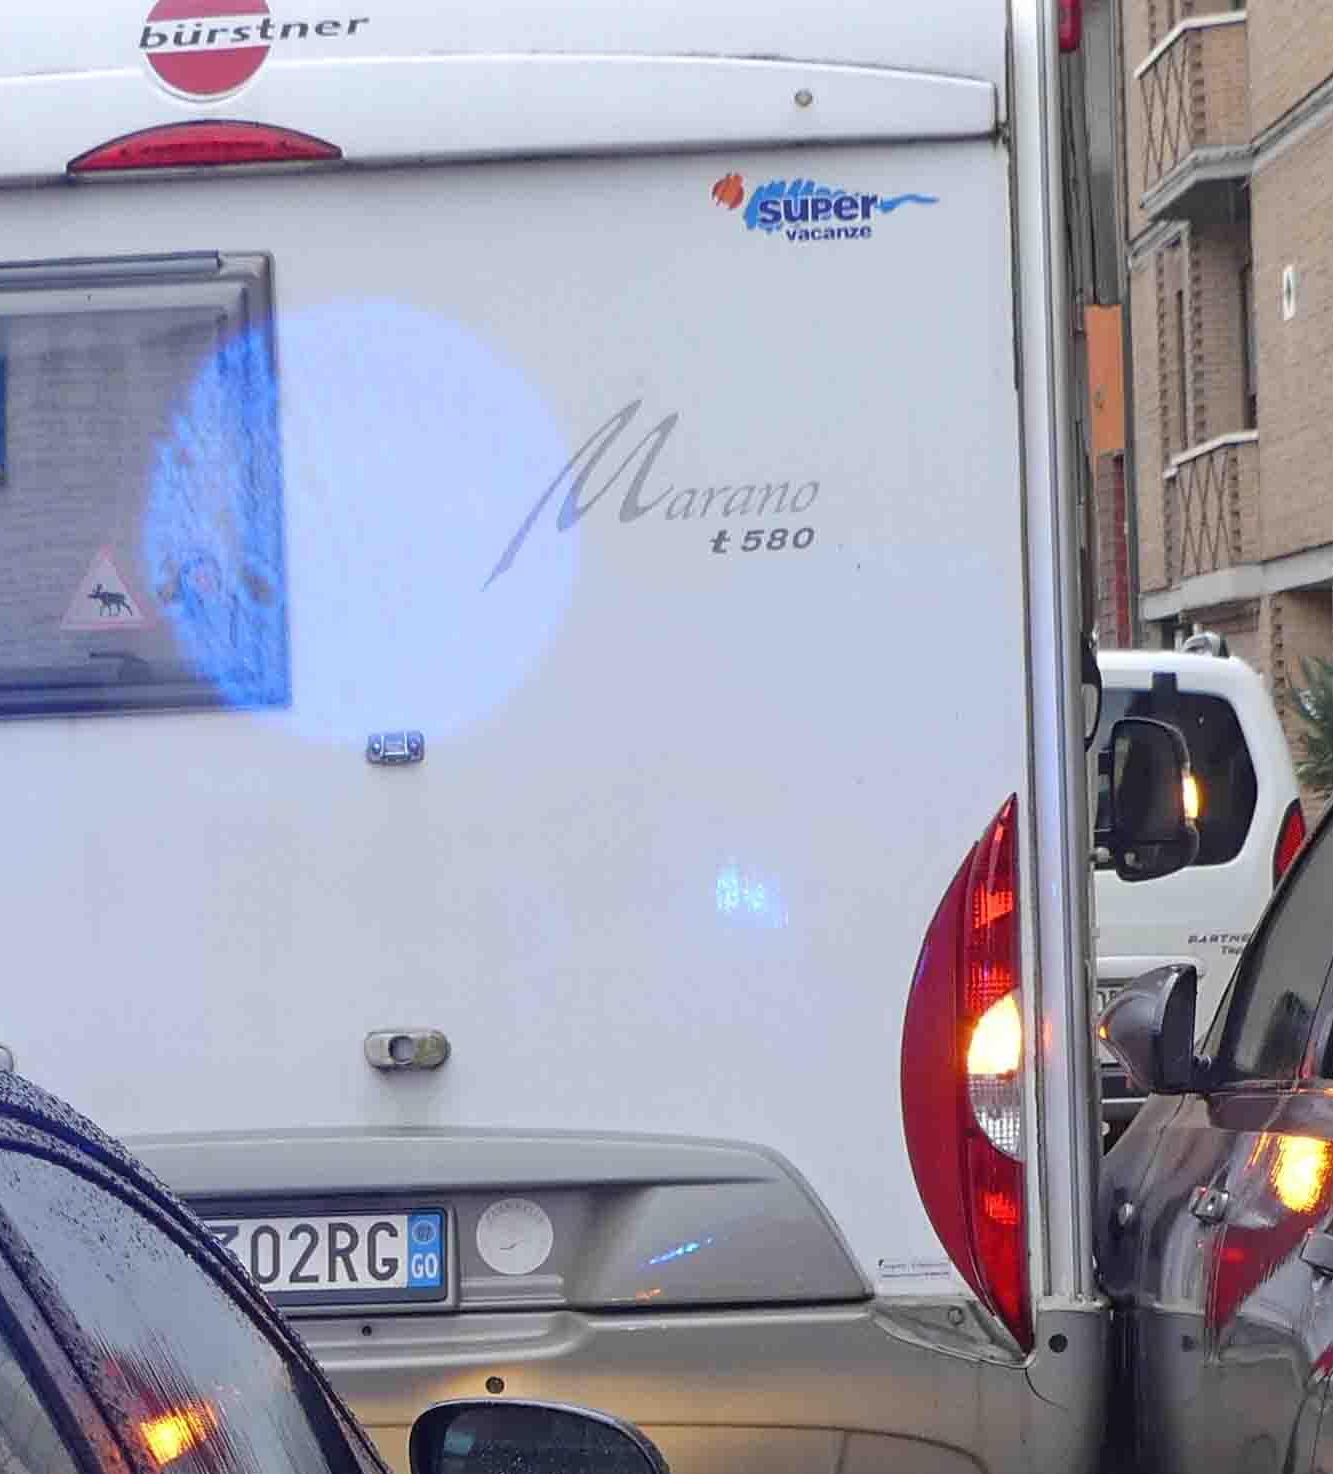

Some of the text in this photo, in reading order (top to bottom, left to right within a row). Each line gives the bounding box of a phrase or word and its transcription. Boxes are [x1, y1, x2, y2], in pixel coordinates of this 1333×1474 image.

[139, 17, 369, 49] bürstner
[786, 225, 872, 241] vacanze
[480, 399, 820, 592] Marano
[740, 527, 815, 552] 580
[411, 1253, 438, 1279] GO
